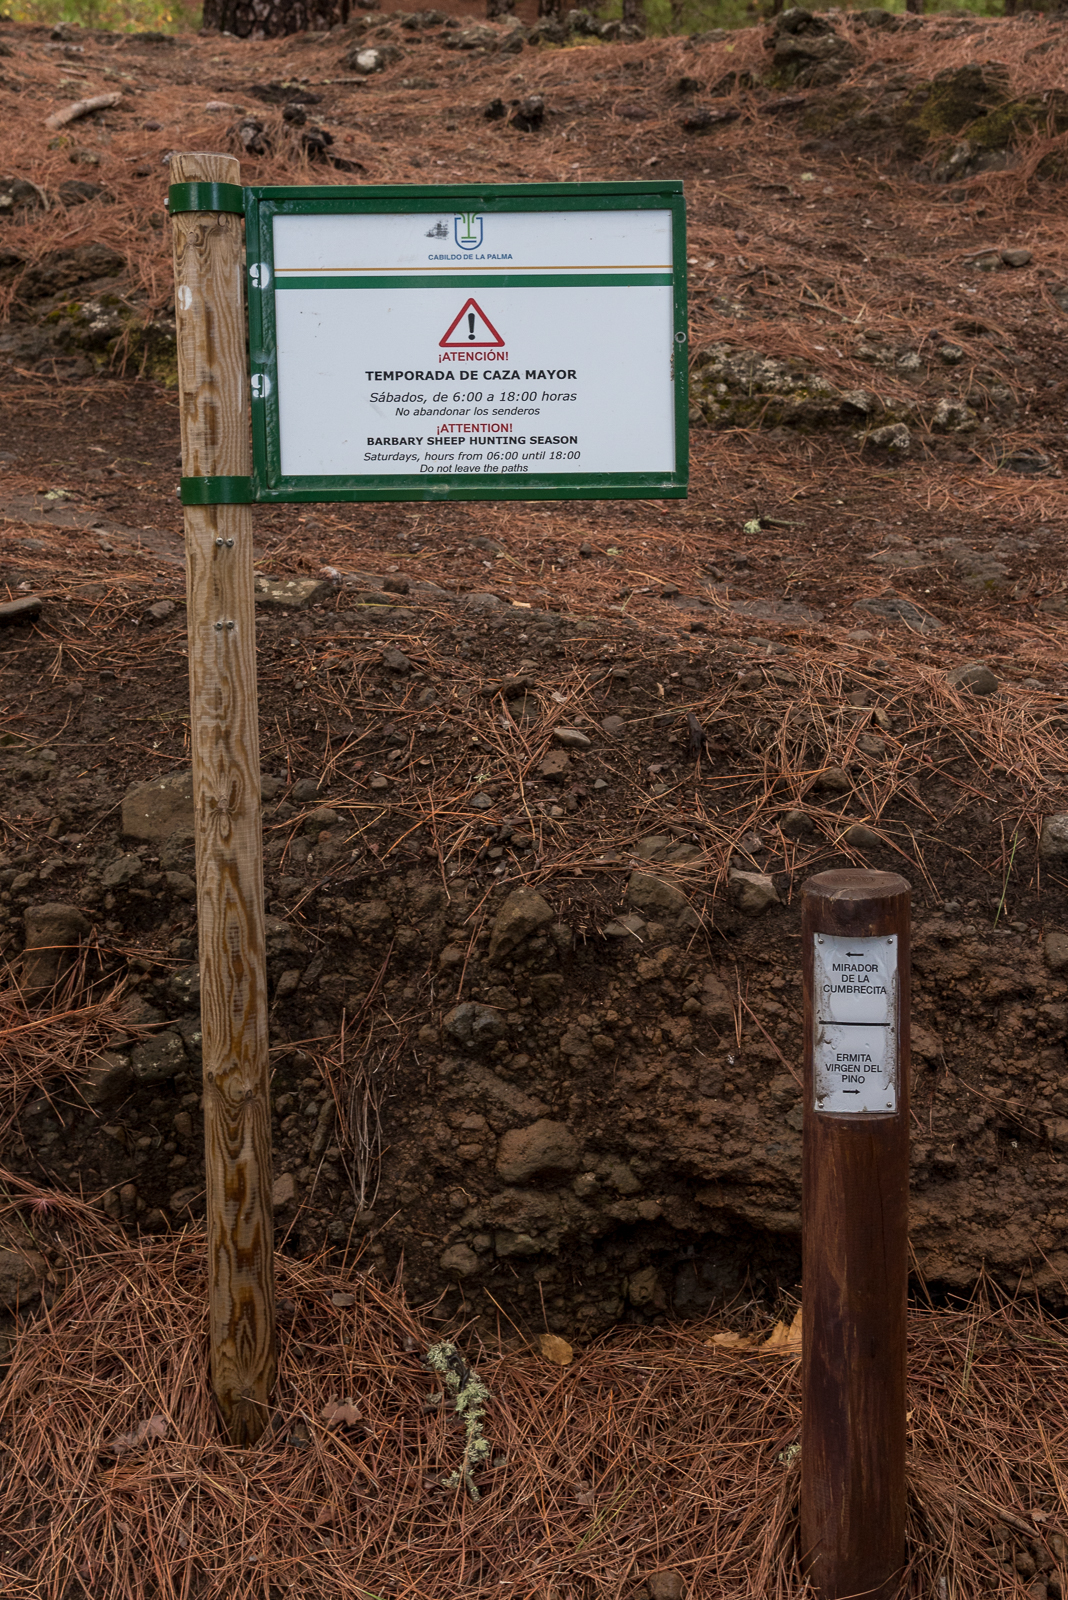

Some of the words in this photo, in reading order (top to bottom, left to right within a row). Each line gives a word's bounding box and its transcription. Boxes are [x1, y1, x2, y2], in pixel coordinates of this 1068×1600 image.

[365, 371, 454, 381] TEMPORADA
[459, 370, 479, 380] DE
[483, 370, 520, 380] CAZA
[525, 369, 577, 380] MAYOR
[369, 392, 428, 404] Sábados,
[432, 392, 448, 402] de
[453, 392, 483, 402] 6:00
[486, 394, 495, 402] a
[500, 391, 538, 402] 18:00
[541, 391, 578, 401] horas
[395, 408, 410, 416] No
[413, 407, 470, 416] abandonar
[474, 407, 488, 416] los
[492, 406, 540, 415] senderos
[367, 437, 423, 446] BARBARY
[427, 437, 466, 445] SHEEP
[469, 436, 526, 445] HUNTING
[529, 436, 578, 445] SEASON
[363, 452, 420, 462] Saturdays,
[425, 452, 454, 461] hours
[458, 452, 483, 461] from
[486, 452, 519, 460] 06:00
[522, 451, 546, 460] until
[549, 451, 581, 460] 18:00
[420, 464, 434, 473] Do
[455, 464, 480, 472] leave
[483, 464, 499, 472] the
[501, 464, 529, 474] paths
[832, 963, 879, 972] MIRADOR
[841, 975, 855, 983] DE
[858, 975, 870, 983] LA
[823, 985, 887, 994] CUMBRECITA
[836, 1054, 872, 1062] ERMITA
[825, 1063, 861, 1072] VIRGEN
[842, 1075, 865, 1084] PINO
